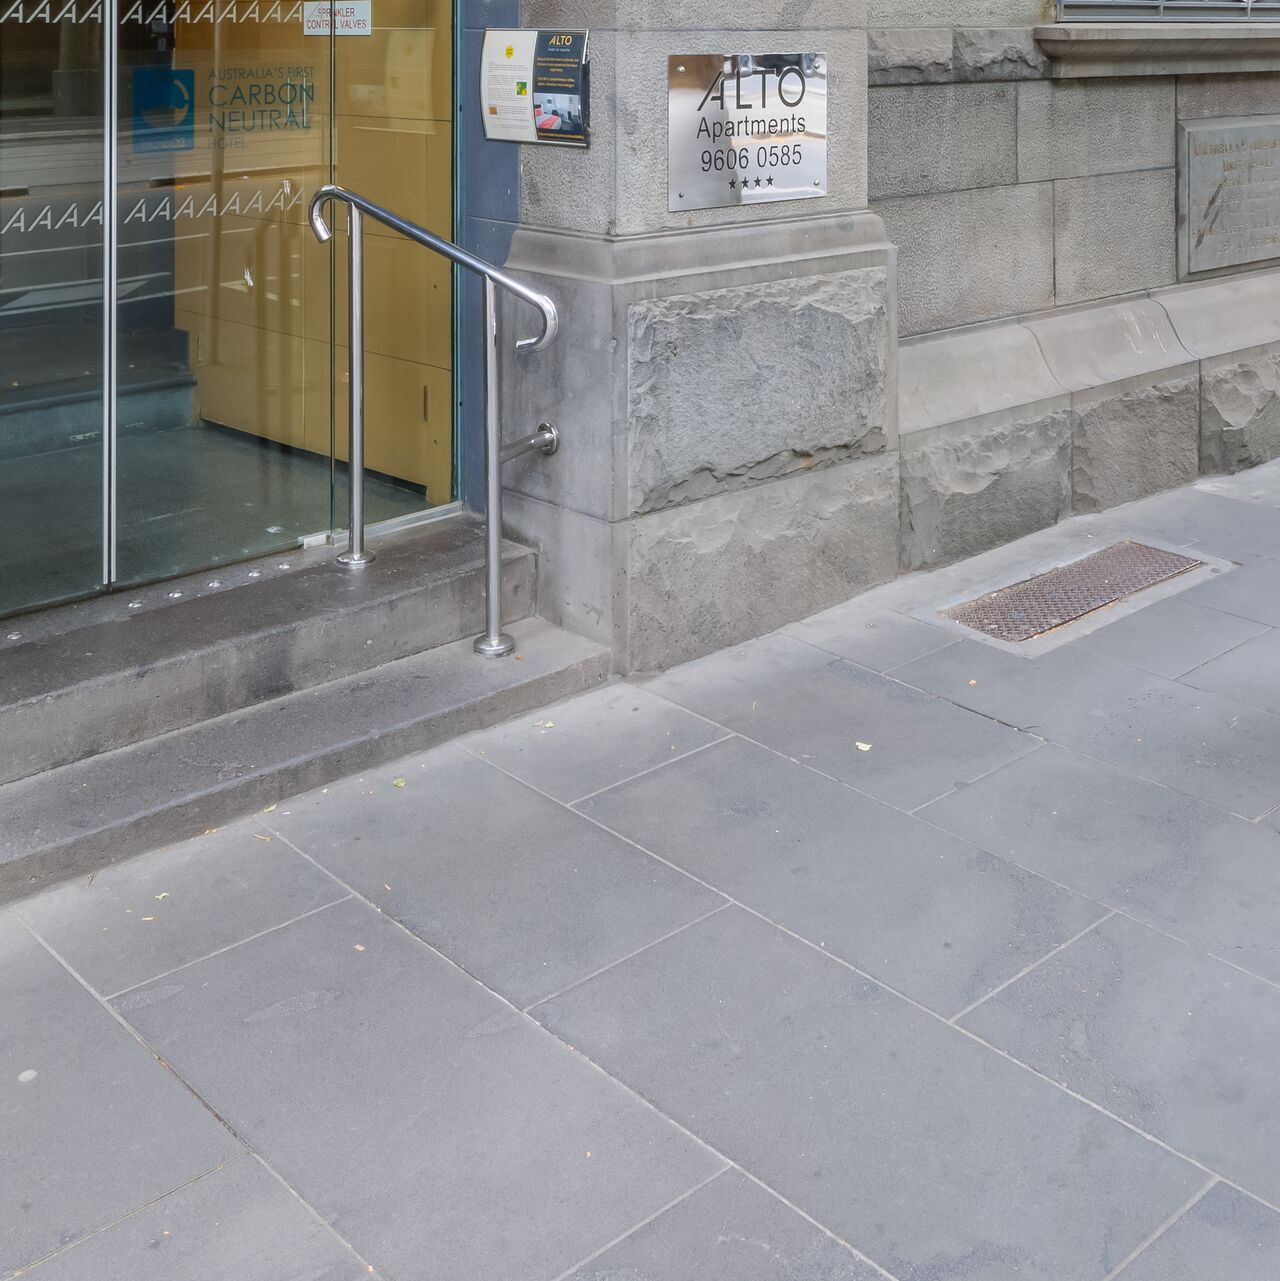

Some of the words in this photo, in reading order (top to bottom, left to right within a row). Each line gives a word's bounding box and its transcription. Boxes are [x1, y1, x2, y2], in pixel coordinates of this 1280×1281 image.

[317, 7, 355, 17] SPRNKLER
[306, 19, 338, 29] CONTRL
[340, 19, 367, 29] VALVES
[549, 35, 572, 46] ALTO
[208, 67, 284, 81] AUSTRALIA'S
[287, 66, 316, 79] FIRST
[208, 83, 315, 107] CARBON
[697, 66, 806, 111] ALTO
[209, 109, 312, 133] NEUTRAL
[697, 113, 806, 143] Apartments
[208, 137, 248, 151] HOTEL
[701, 146, 749, 172] 9606
[757, 144, 802, 168] 0585
